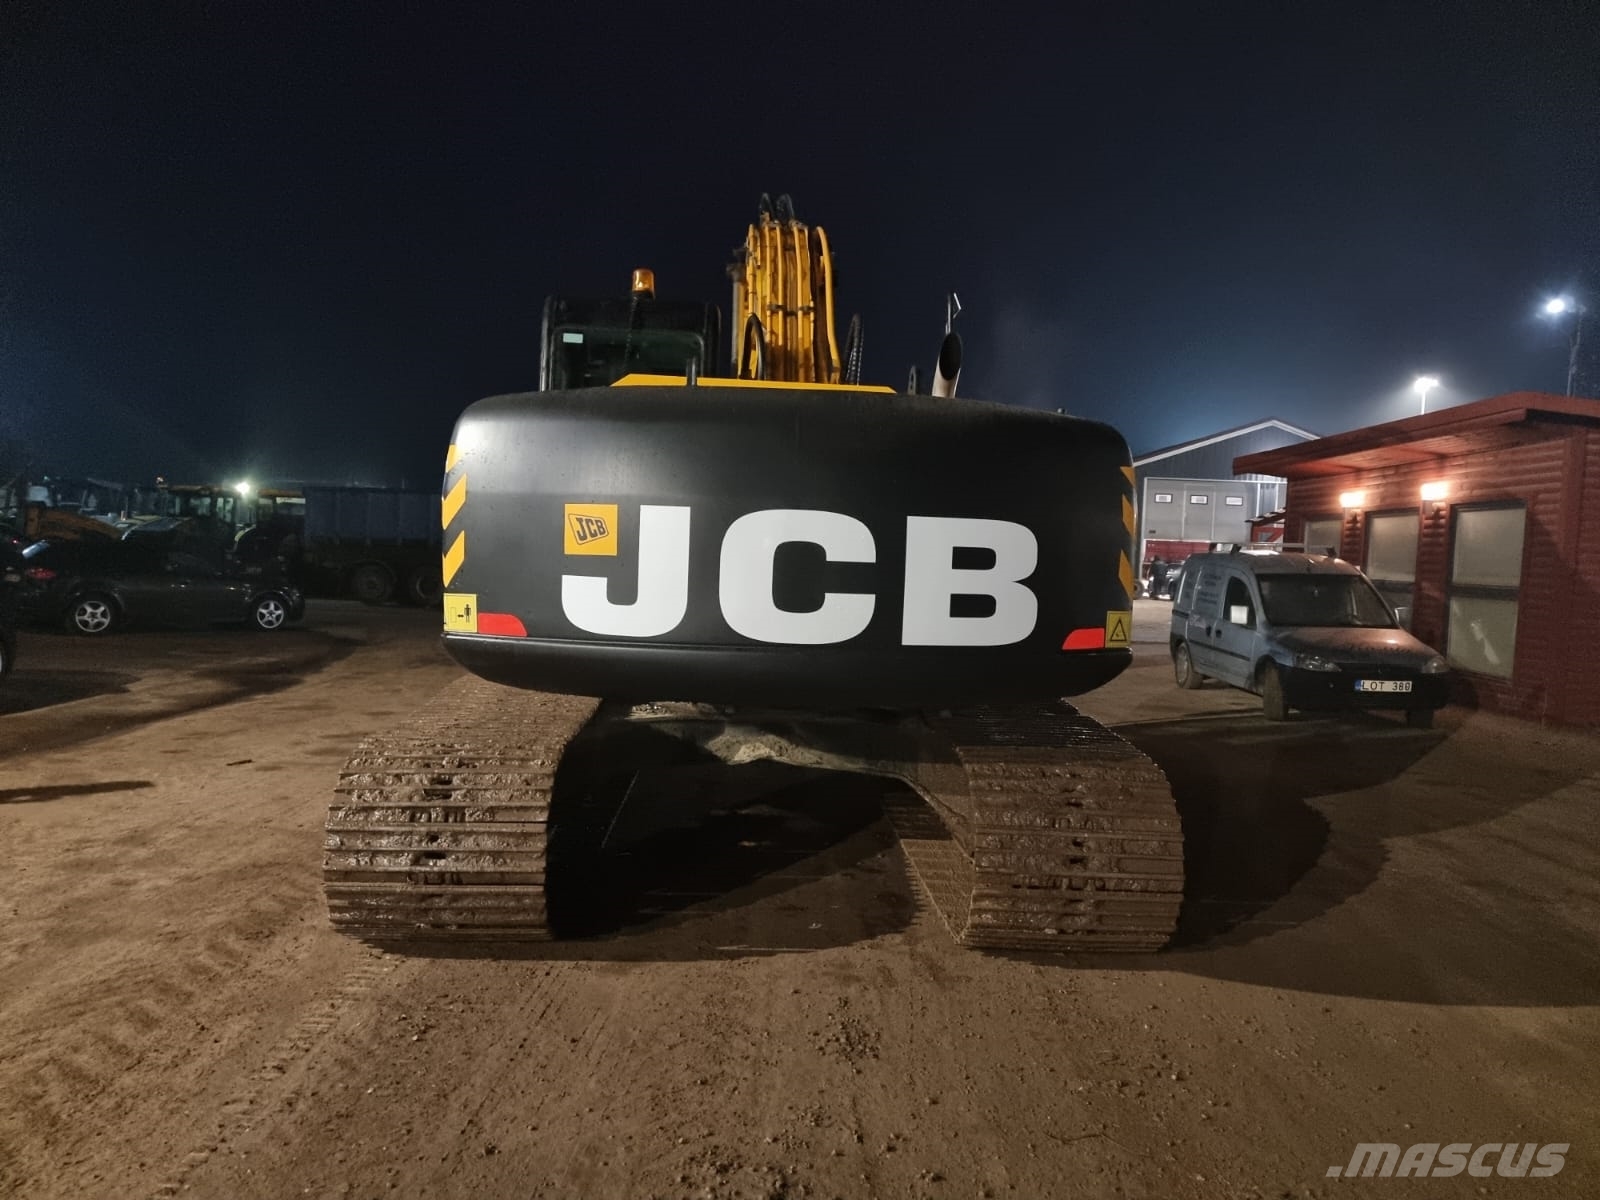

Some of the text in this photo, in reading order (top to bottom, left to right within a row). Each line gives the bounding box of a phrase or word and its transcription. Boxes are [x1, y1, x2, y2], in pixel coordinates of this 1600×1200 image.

[575, 517, 607, 541] JCB
[562, 505, 1038, 645] JCB
[1362, 680, 1385, 690] LOT
